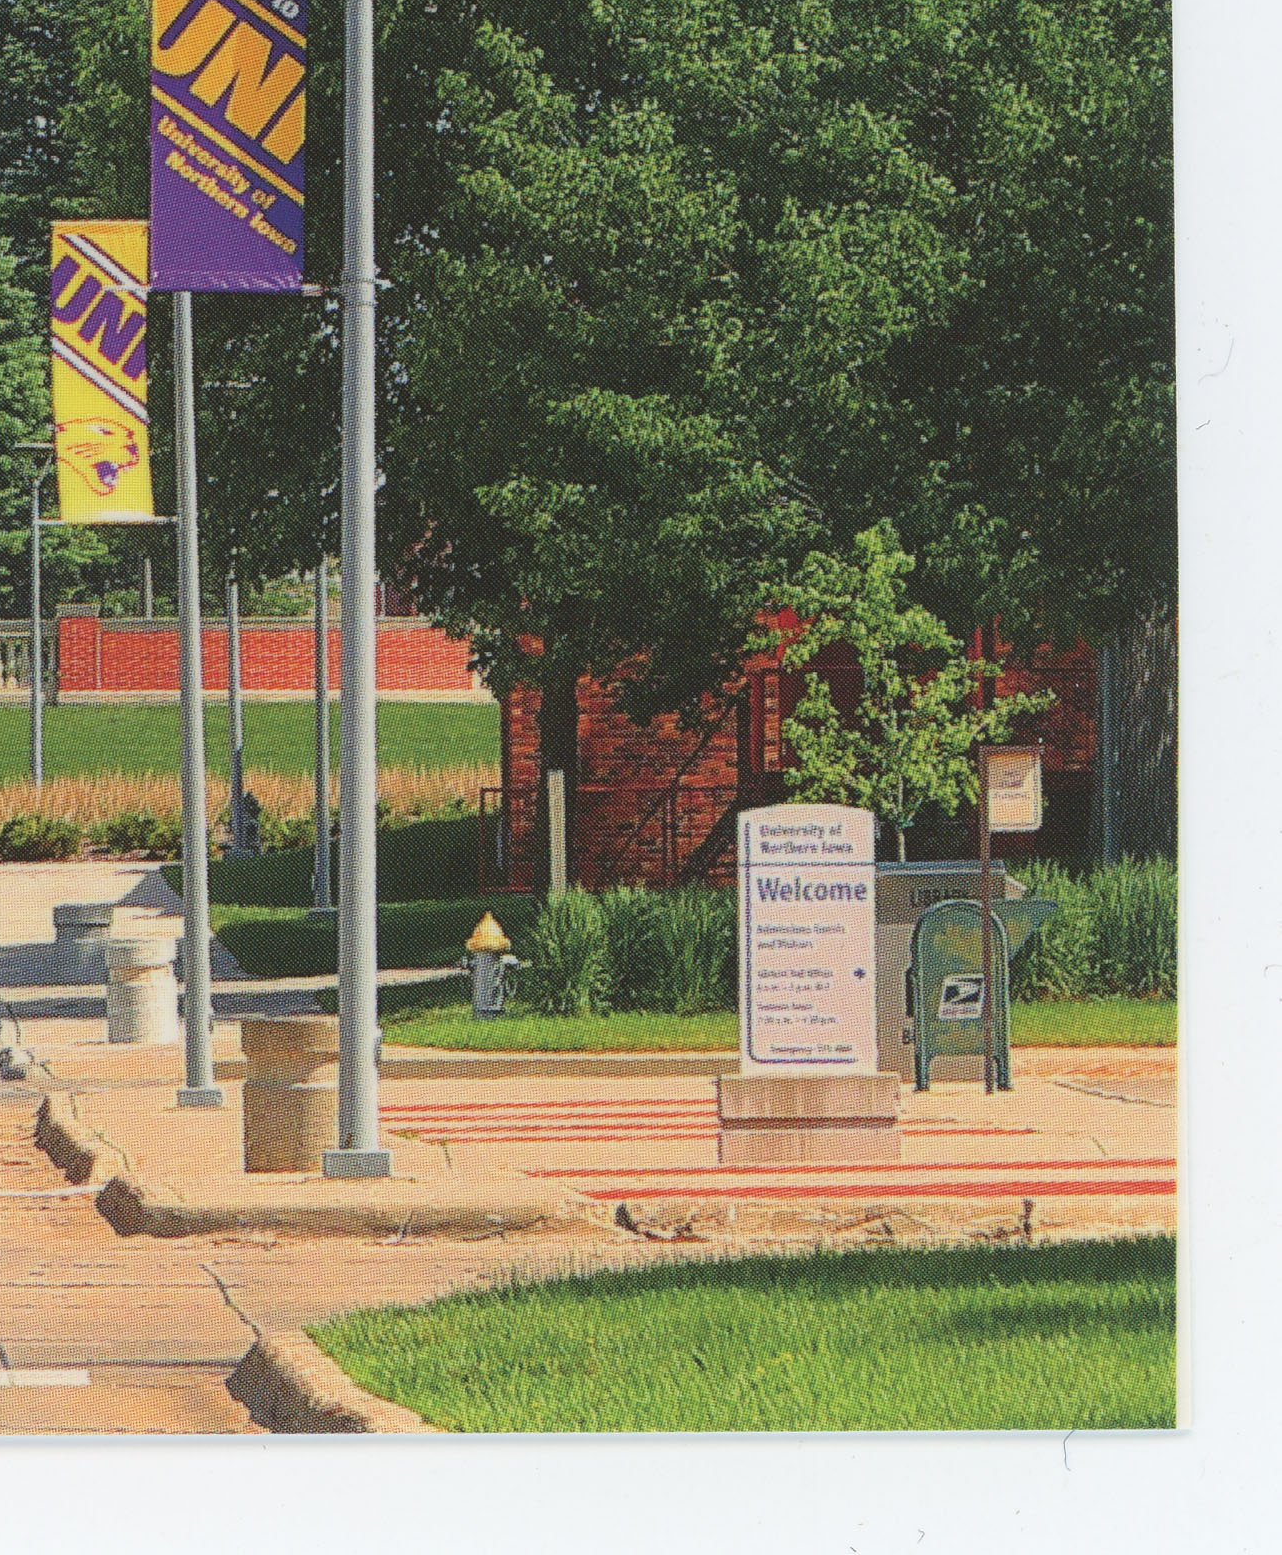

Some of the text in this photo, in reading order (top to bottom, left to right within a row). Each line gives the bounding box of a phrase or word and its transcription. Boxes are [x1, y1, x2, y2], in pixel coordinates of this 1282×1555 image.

[157, 115, 277, 210] University of
[165, 150, 297, 255] Northern Iowa
[51, 255, 147, 381] UNI
[758, 823, 843, 839] University of
[759, 841, 854, 854] Northern Iowa
[757, 876, 868, 902] Welcome
